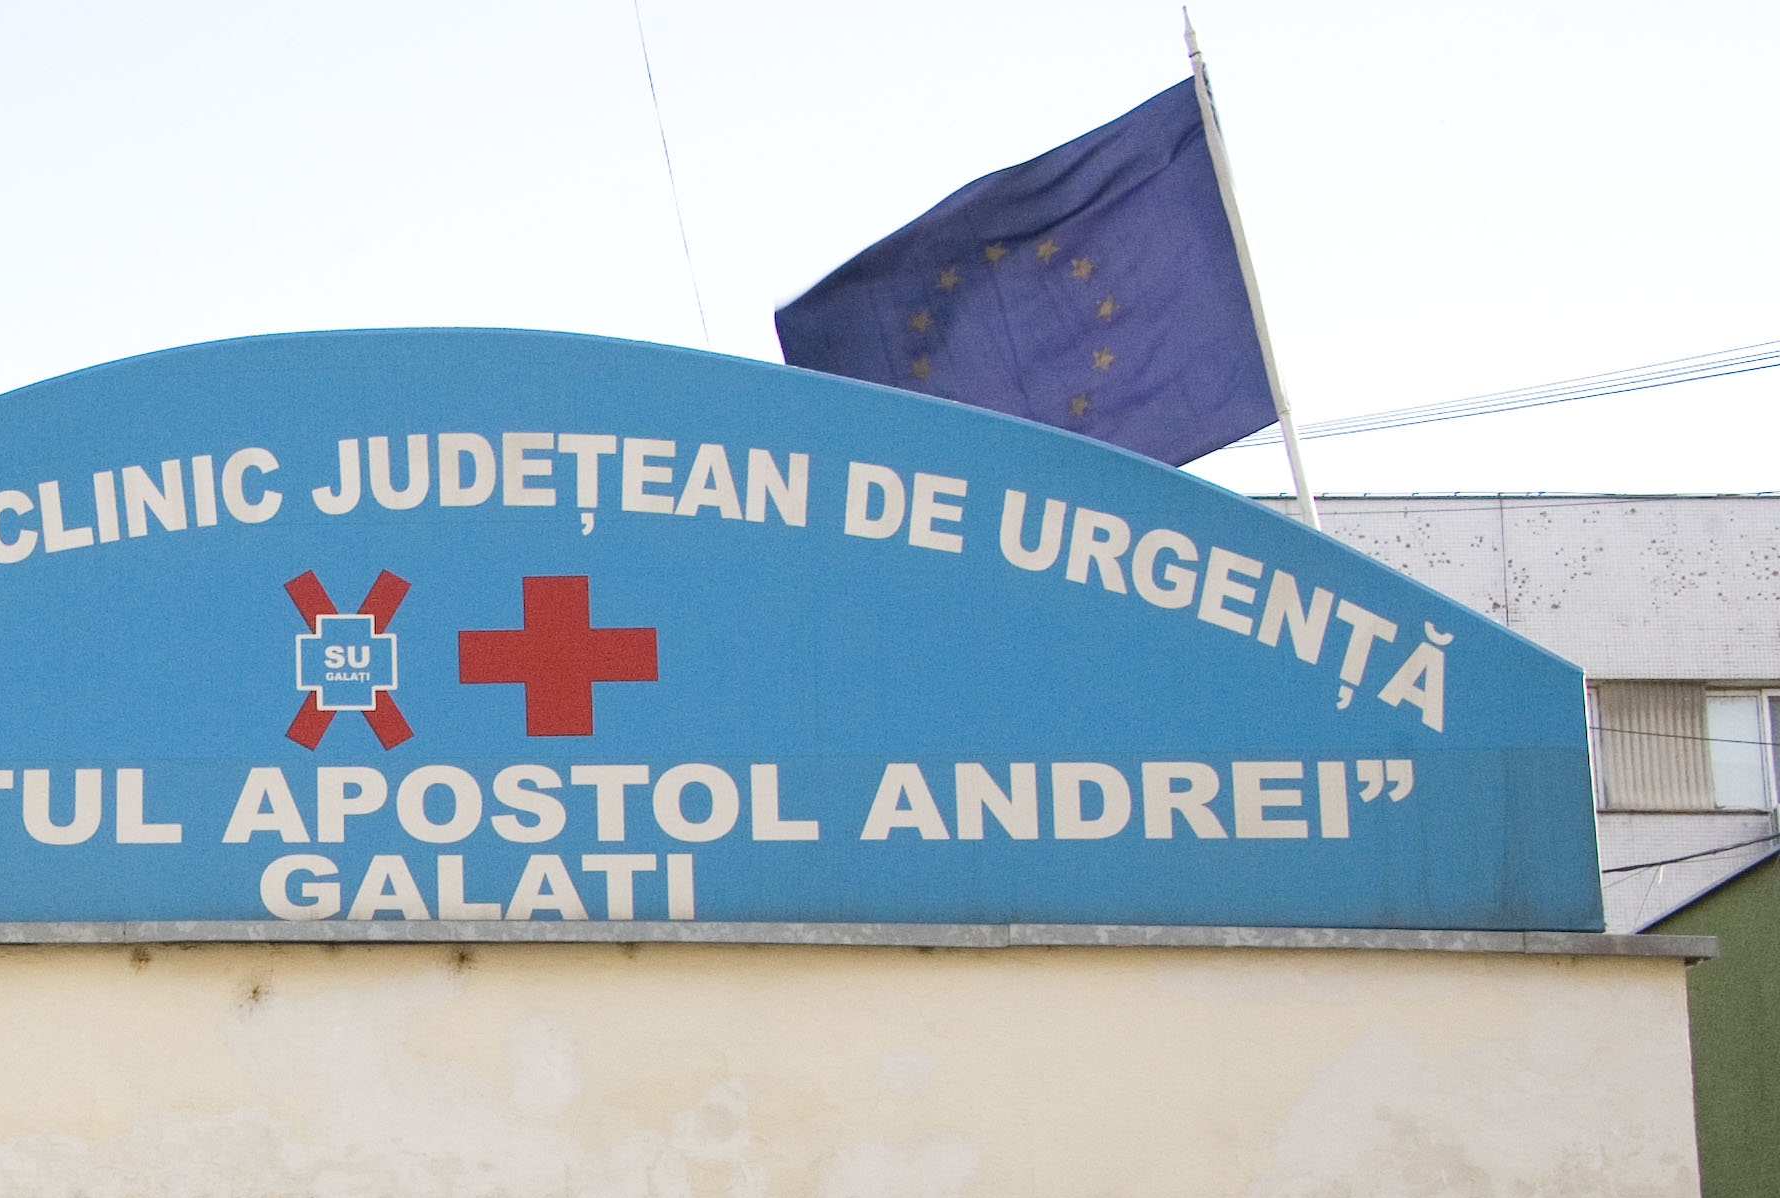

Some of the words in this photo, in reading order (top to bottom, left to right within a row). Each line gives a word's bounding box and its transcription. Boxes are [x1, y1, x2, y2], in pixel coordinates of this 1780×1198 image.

[311, 432, 809, 536] JUDEȚEAN
[844, 461, 968, 553] DE
[999, 489, 1454, 732] URGENȚĂ
[324, 645, 371, 669] SU
[222, 763, 819, 844] APOSTOL
[259, 853, 695, 921] GALATI
